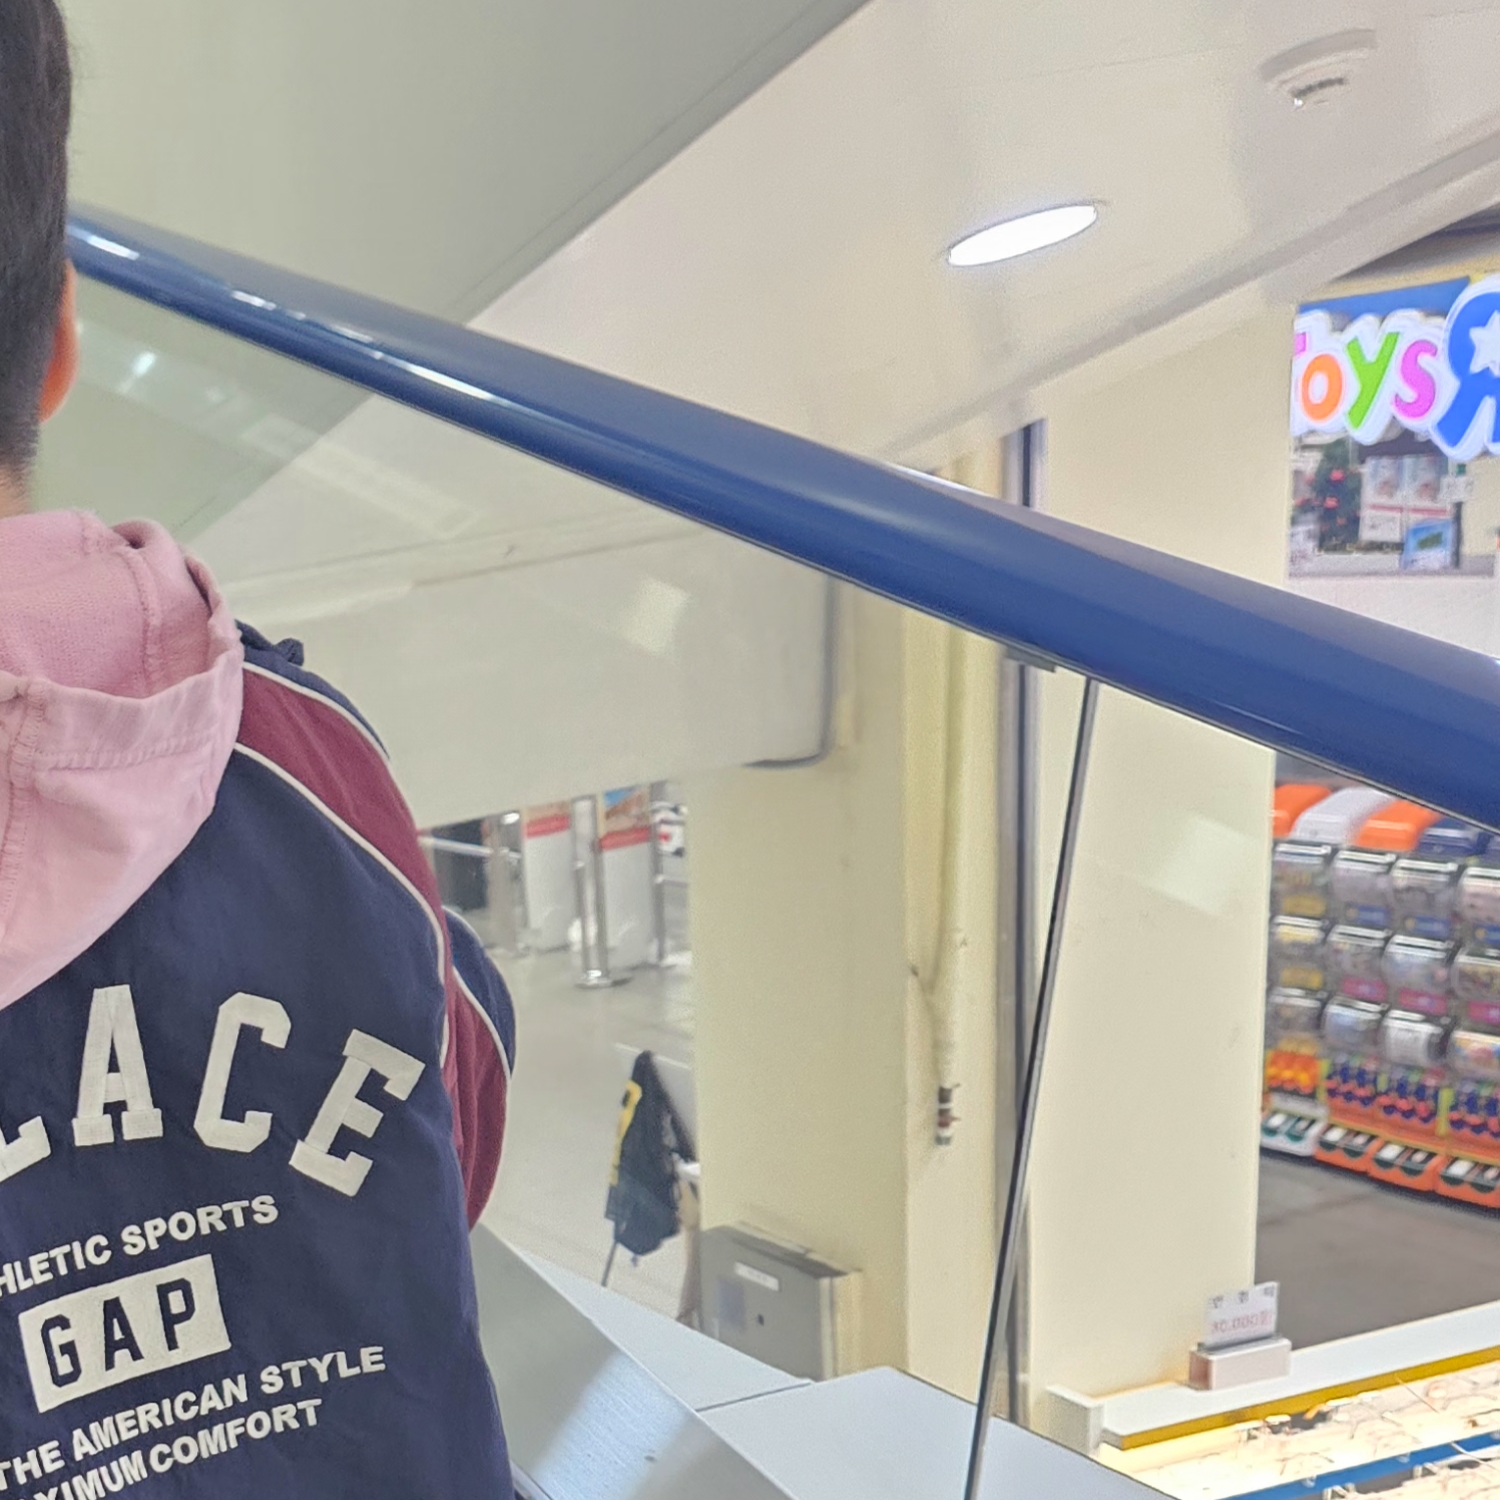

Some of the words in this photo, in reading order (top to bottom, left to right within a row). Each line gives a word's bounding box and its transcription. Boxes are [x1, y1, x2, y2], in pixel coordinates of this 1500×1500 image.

[121, 1195, 279, 1255] SPORTS
[39, 1277, 198, 1389] GAP
[72, 1373, 249, 1462] AMERICAN
[260, 1346, 387, 1394] STYLE
[149, 1398, 323, 1474] COMFORT
